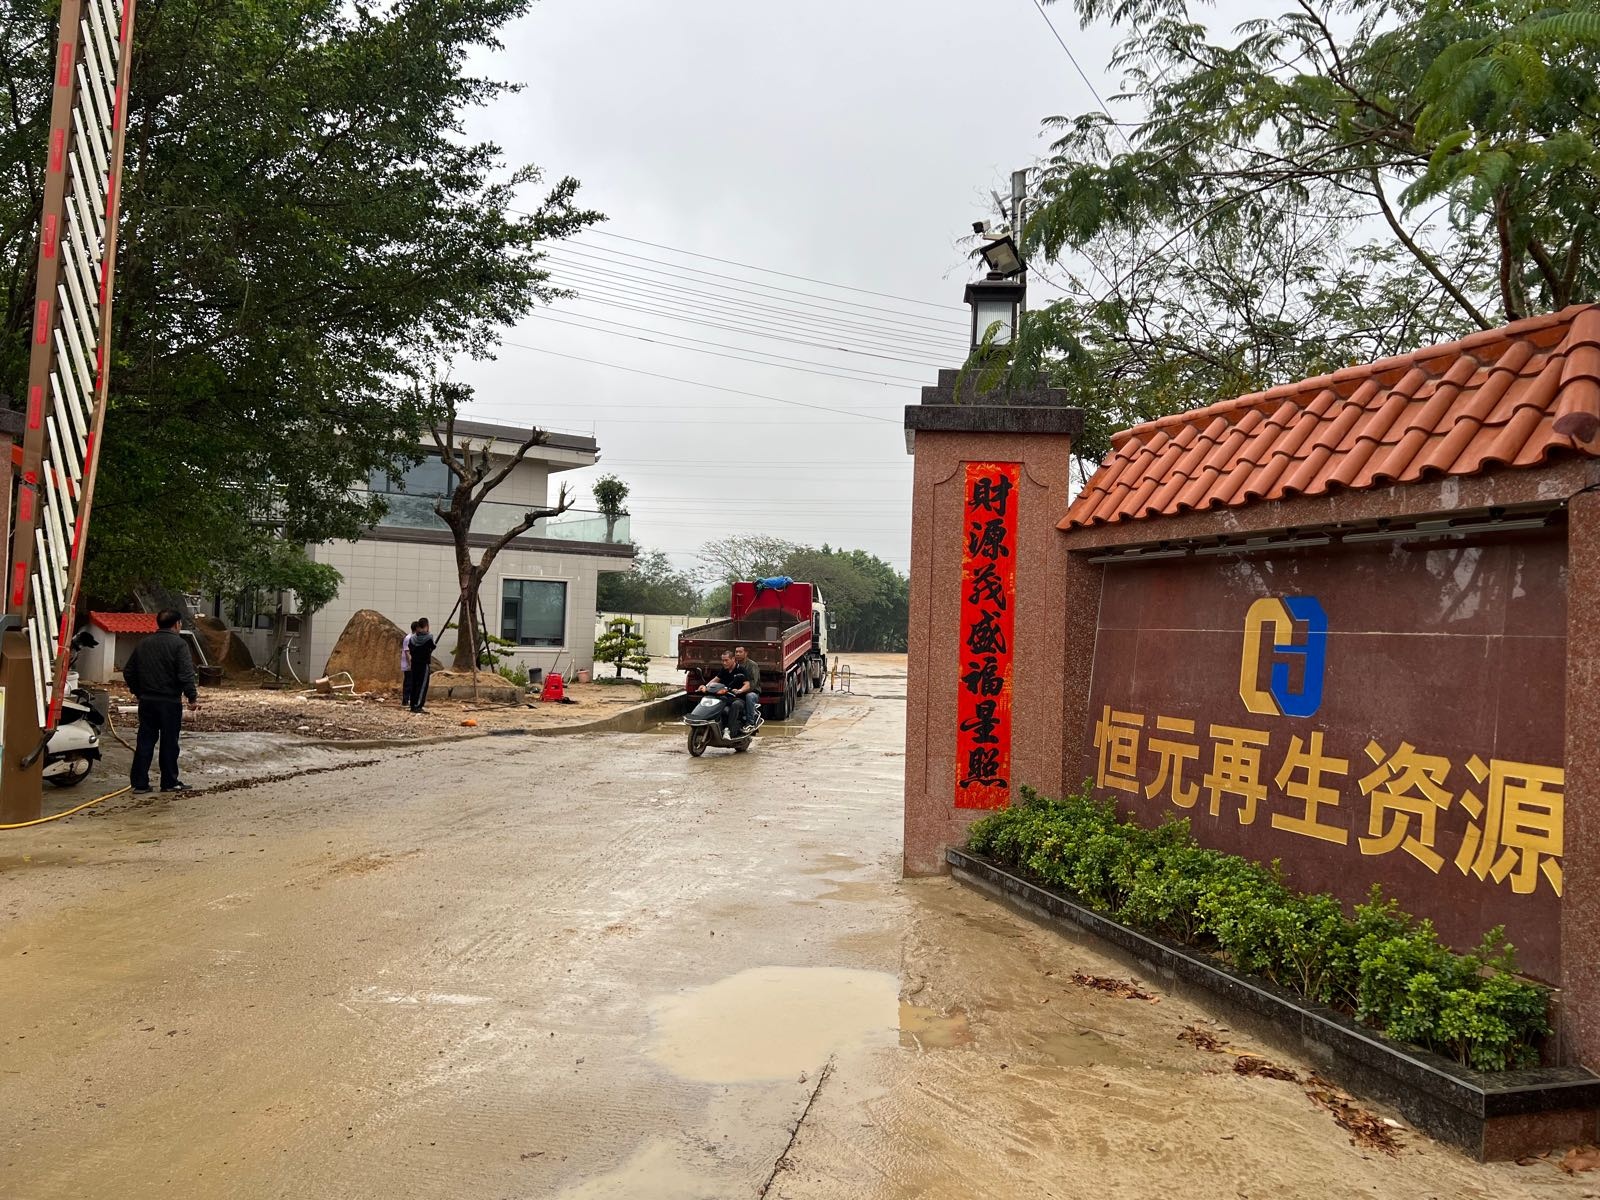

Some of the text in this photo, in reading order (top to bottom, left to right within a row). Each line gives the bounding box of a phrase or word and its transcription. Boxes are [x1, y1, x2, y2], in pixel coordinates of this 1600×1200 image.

[1094, 704, 1565, 897] 恒元再生资源
